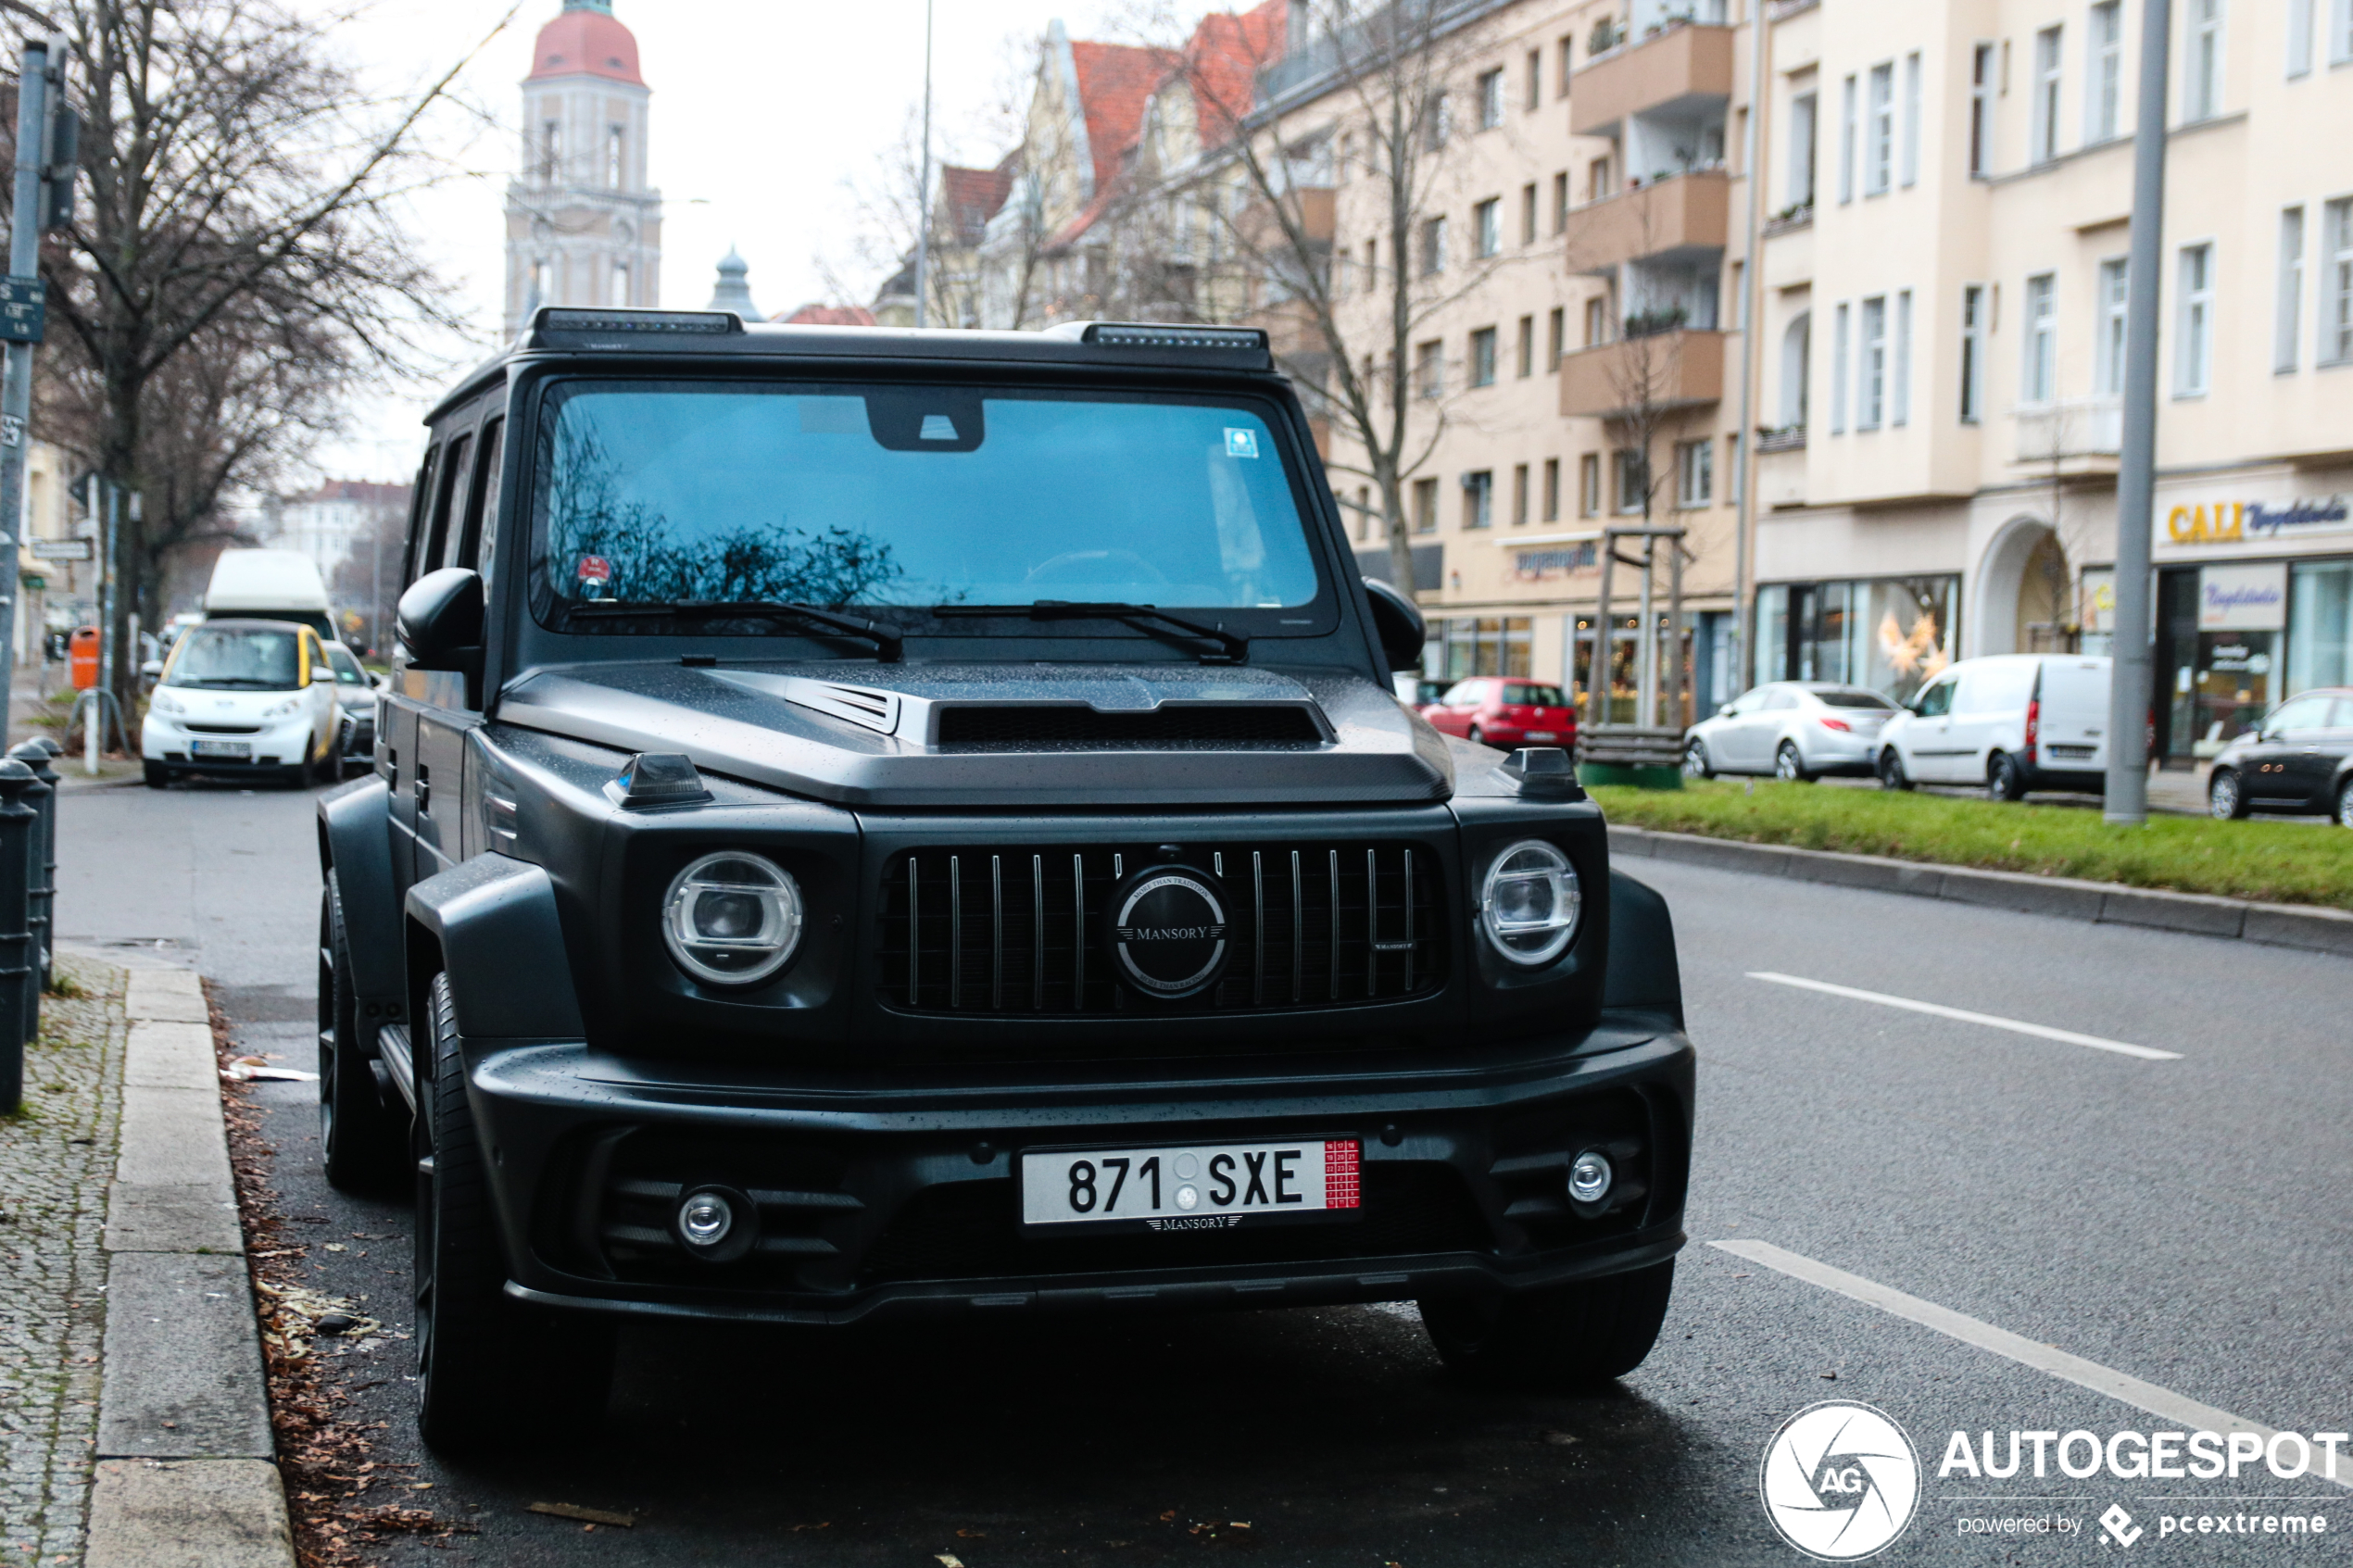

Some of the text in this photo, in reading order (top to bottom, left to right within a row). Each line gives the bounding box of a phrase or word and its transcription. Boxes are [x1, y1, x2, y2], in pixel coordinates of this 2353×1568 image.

[1134, 877, 1210, 899] MORE THAN TRADITION
[1137, 926, 1207, 940] MANSORY
[1139, 973, 1158, 987] MORE
[1179, 972, 1205, 987] RACING
[1068, 1149, 1302, 1213] 871 SXE
[1164, 1216, 1226, 1231] MANSORY
